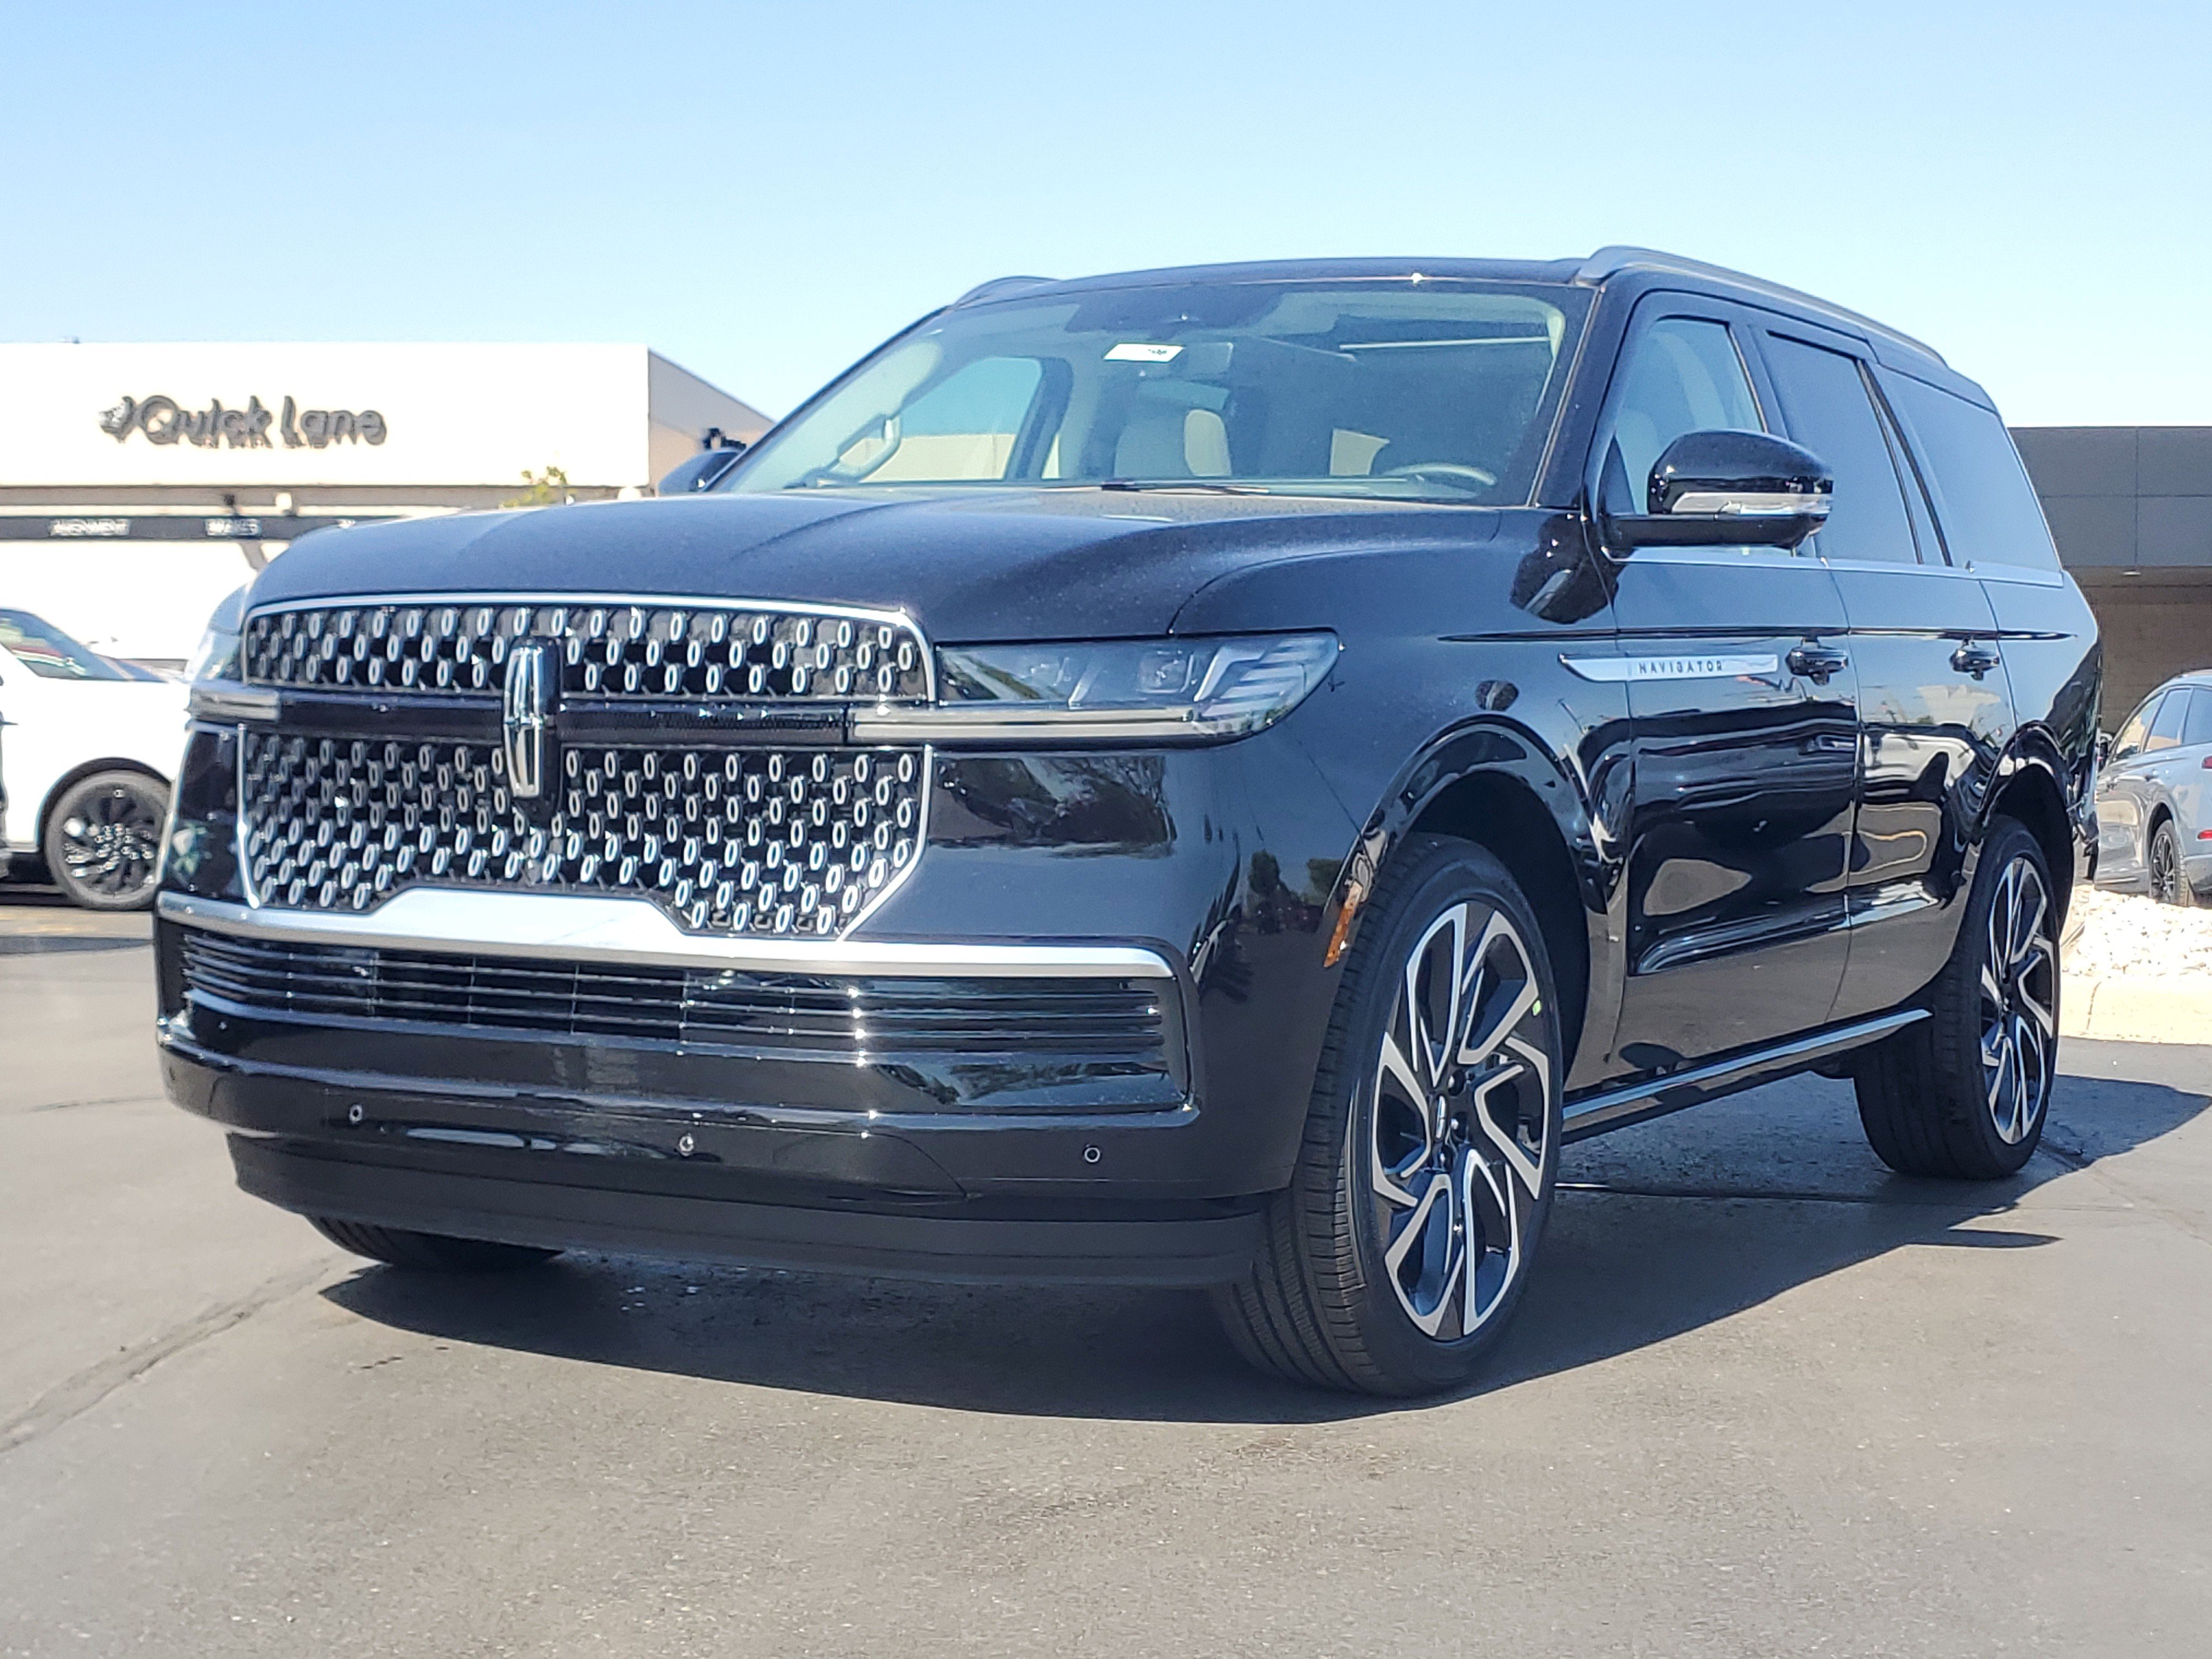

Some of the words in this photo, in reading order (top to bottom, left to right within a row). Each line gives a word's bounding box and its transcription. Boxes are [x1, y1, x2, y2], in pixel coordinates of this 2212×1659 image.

[137, 395, 273, 449] Quick
[280, 395, 387, 449] Lane
[1639, 660, 1722, 674] NAVIGATOR
